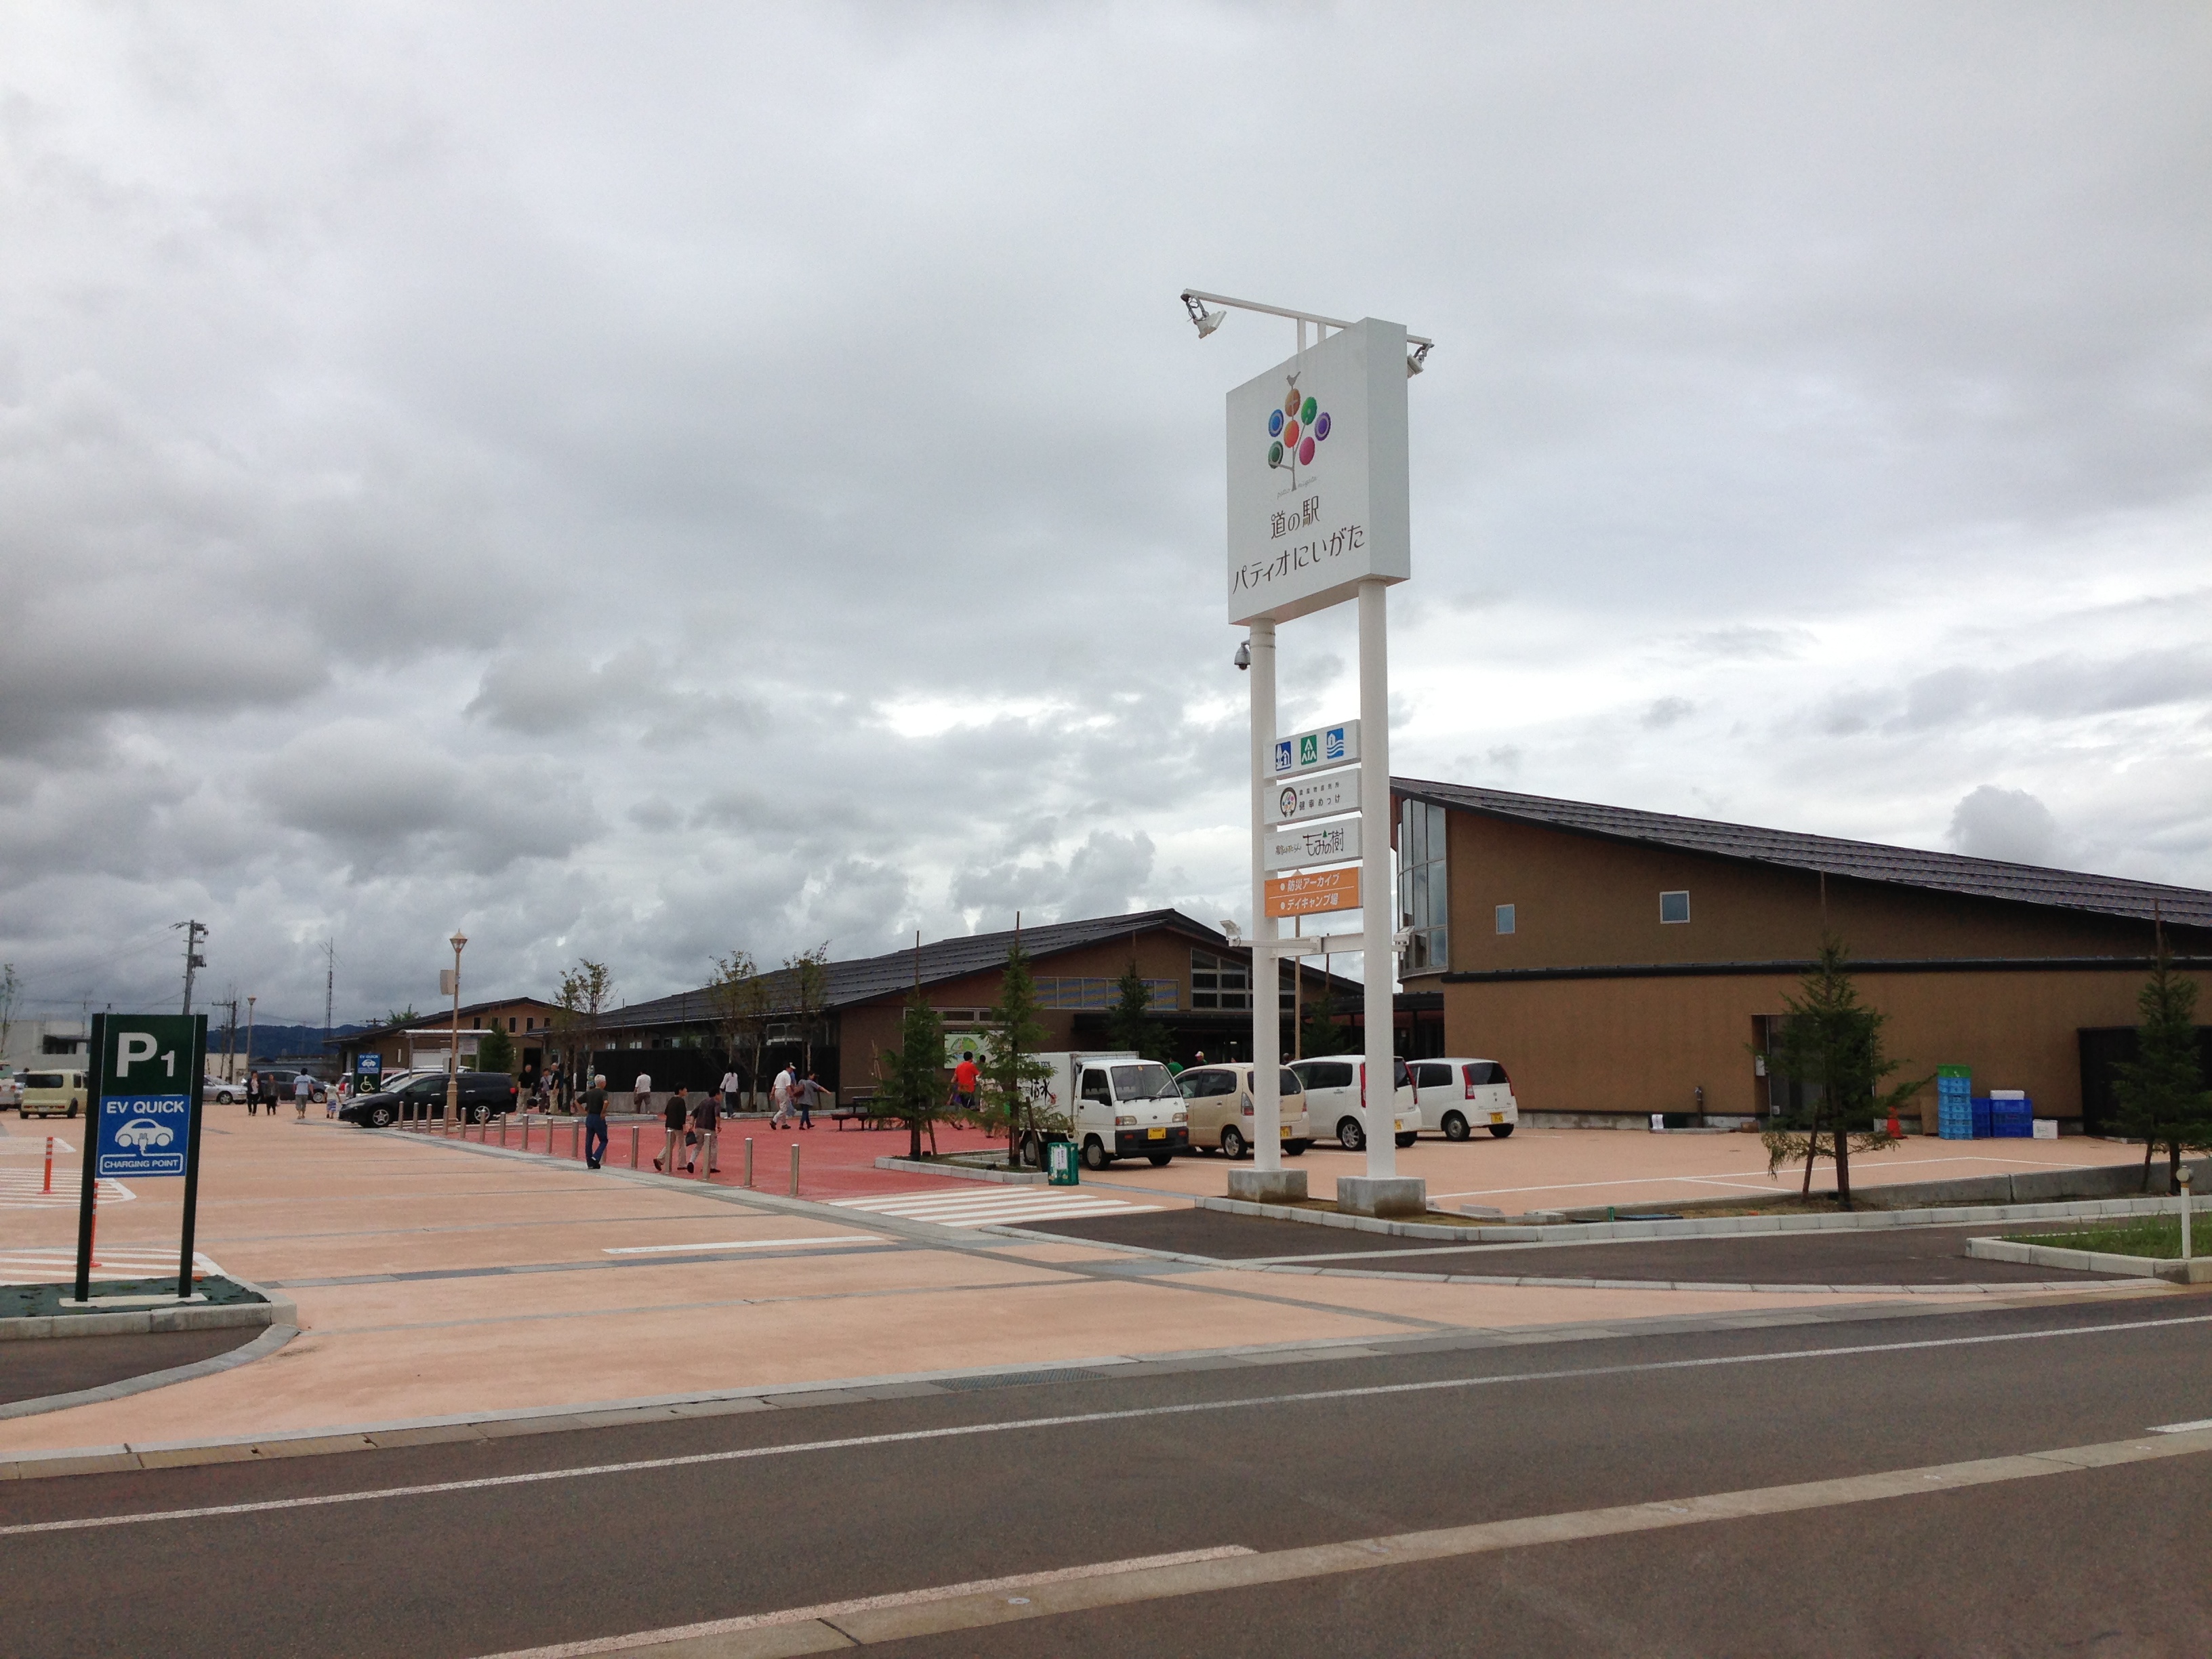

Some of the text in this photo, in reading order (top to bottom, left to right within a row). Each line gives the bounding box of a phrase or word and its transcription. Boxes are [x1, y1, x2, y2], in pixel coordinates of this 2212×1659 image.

[1271, 495, 1320, 539] 道の駅
[1232, 525, 1365, 595] パティオにいがた
[1303, 827, 1344, 856] もみの樹
[1288, 873, 1340, 892] 防災アーカイブ
[106, 1101, 184, 1114] EV QUICK
[104, 1159, 180, 1169] CHARGING POINT
